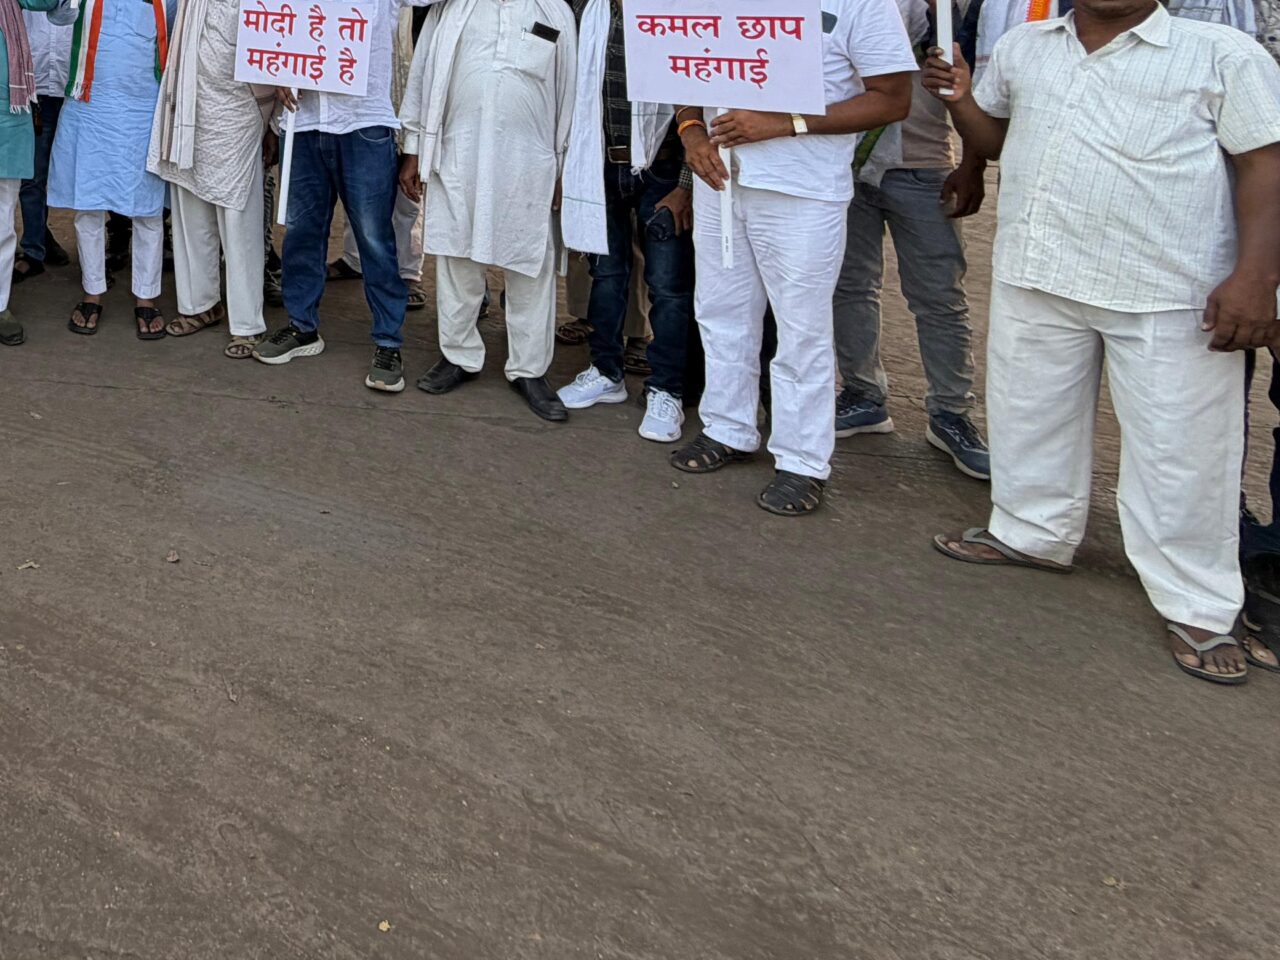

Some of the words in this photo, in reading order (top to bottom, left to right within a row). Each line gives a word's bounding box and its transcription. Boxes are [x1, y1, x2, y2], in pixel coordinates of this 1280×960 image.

[244, 0, 297, 38] मोदी
[308, 4, 326, 42] है
[338, 8, 368, 42] तो
[636, 15, 722, 38] कमल
[736, 16, 804, 40] छाप
[247, 42, 326, 84] महंगाई
[338, 47, 357, 86] है
[668, 47, 769, 89] महंगाई
